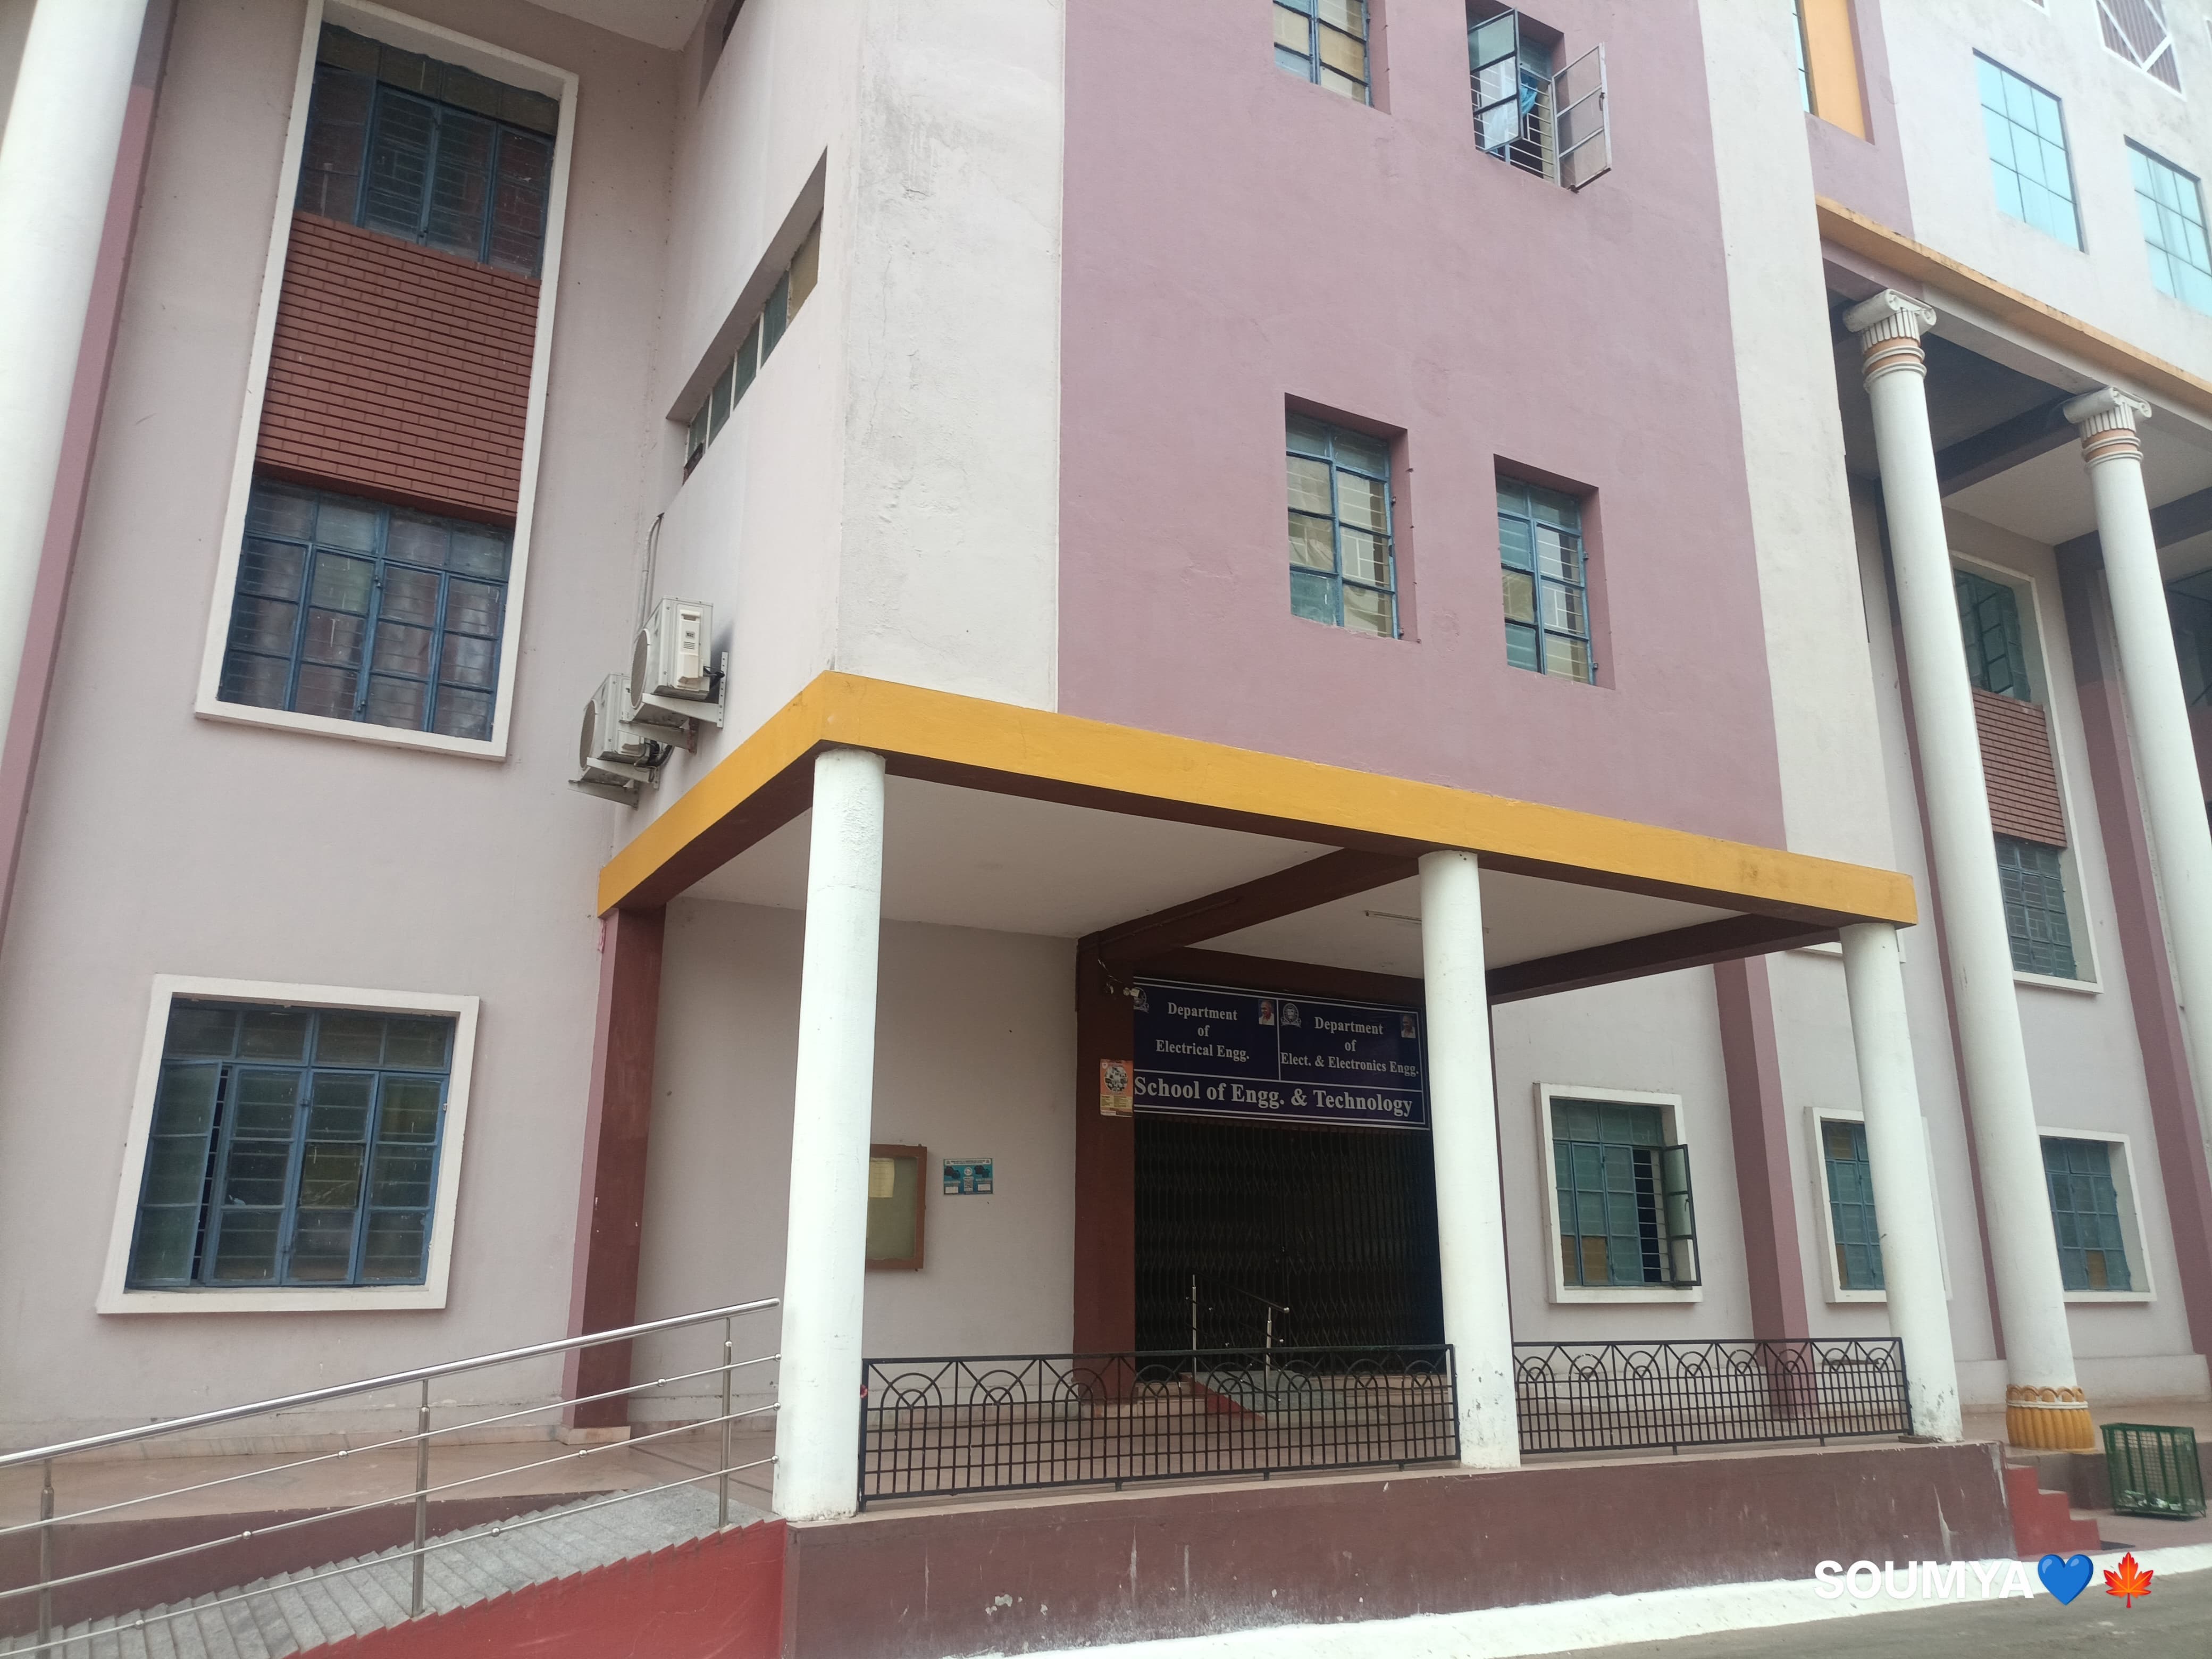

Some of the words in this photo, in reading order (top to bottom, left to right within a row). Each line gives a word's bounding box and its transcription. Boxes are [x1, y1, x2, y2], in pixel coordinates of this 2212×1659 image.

[1167, 1002, 1238, 1021] Department
[1197, 1025, 1210, 1037] of
[1314, 1016, 1384, 1035] Department
[1155, 1039, 1213, 1056] Electrical
[1217, 1044, 1250, 1062] Engg.
[1344, 1040, 1356, 1051] of
[1280, 1052, 1312, 1067] Elect.
[1314, 1055, 1325, 1067] &
[1328, 1055, 1387, 1072] Electronics
[1389, 1061, 1419, 1077] Engg.
[1134, 1076, 1200, 1099] School
[1206, 1083, 1227, 1101] of
[1231, 1083, 1285, 1109] Engg.
[1291, 1088, 1308, 1107] &
[1313, 1090, 1413, 1117] Technology
